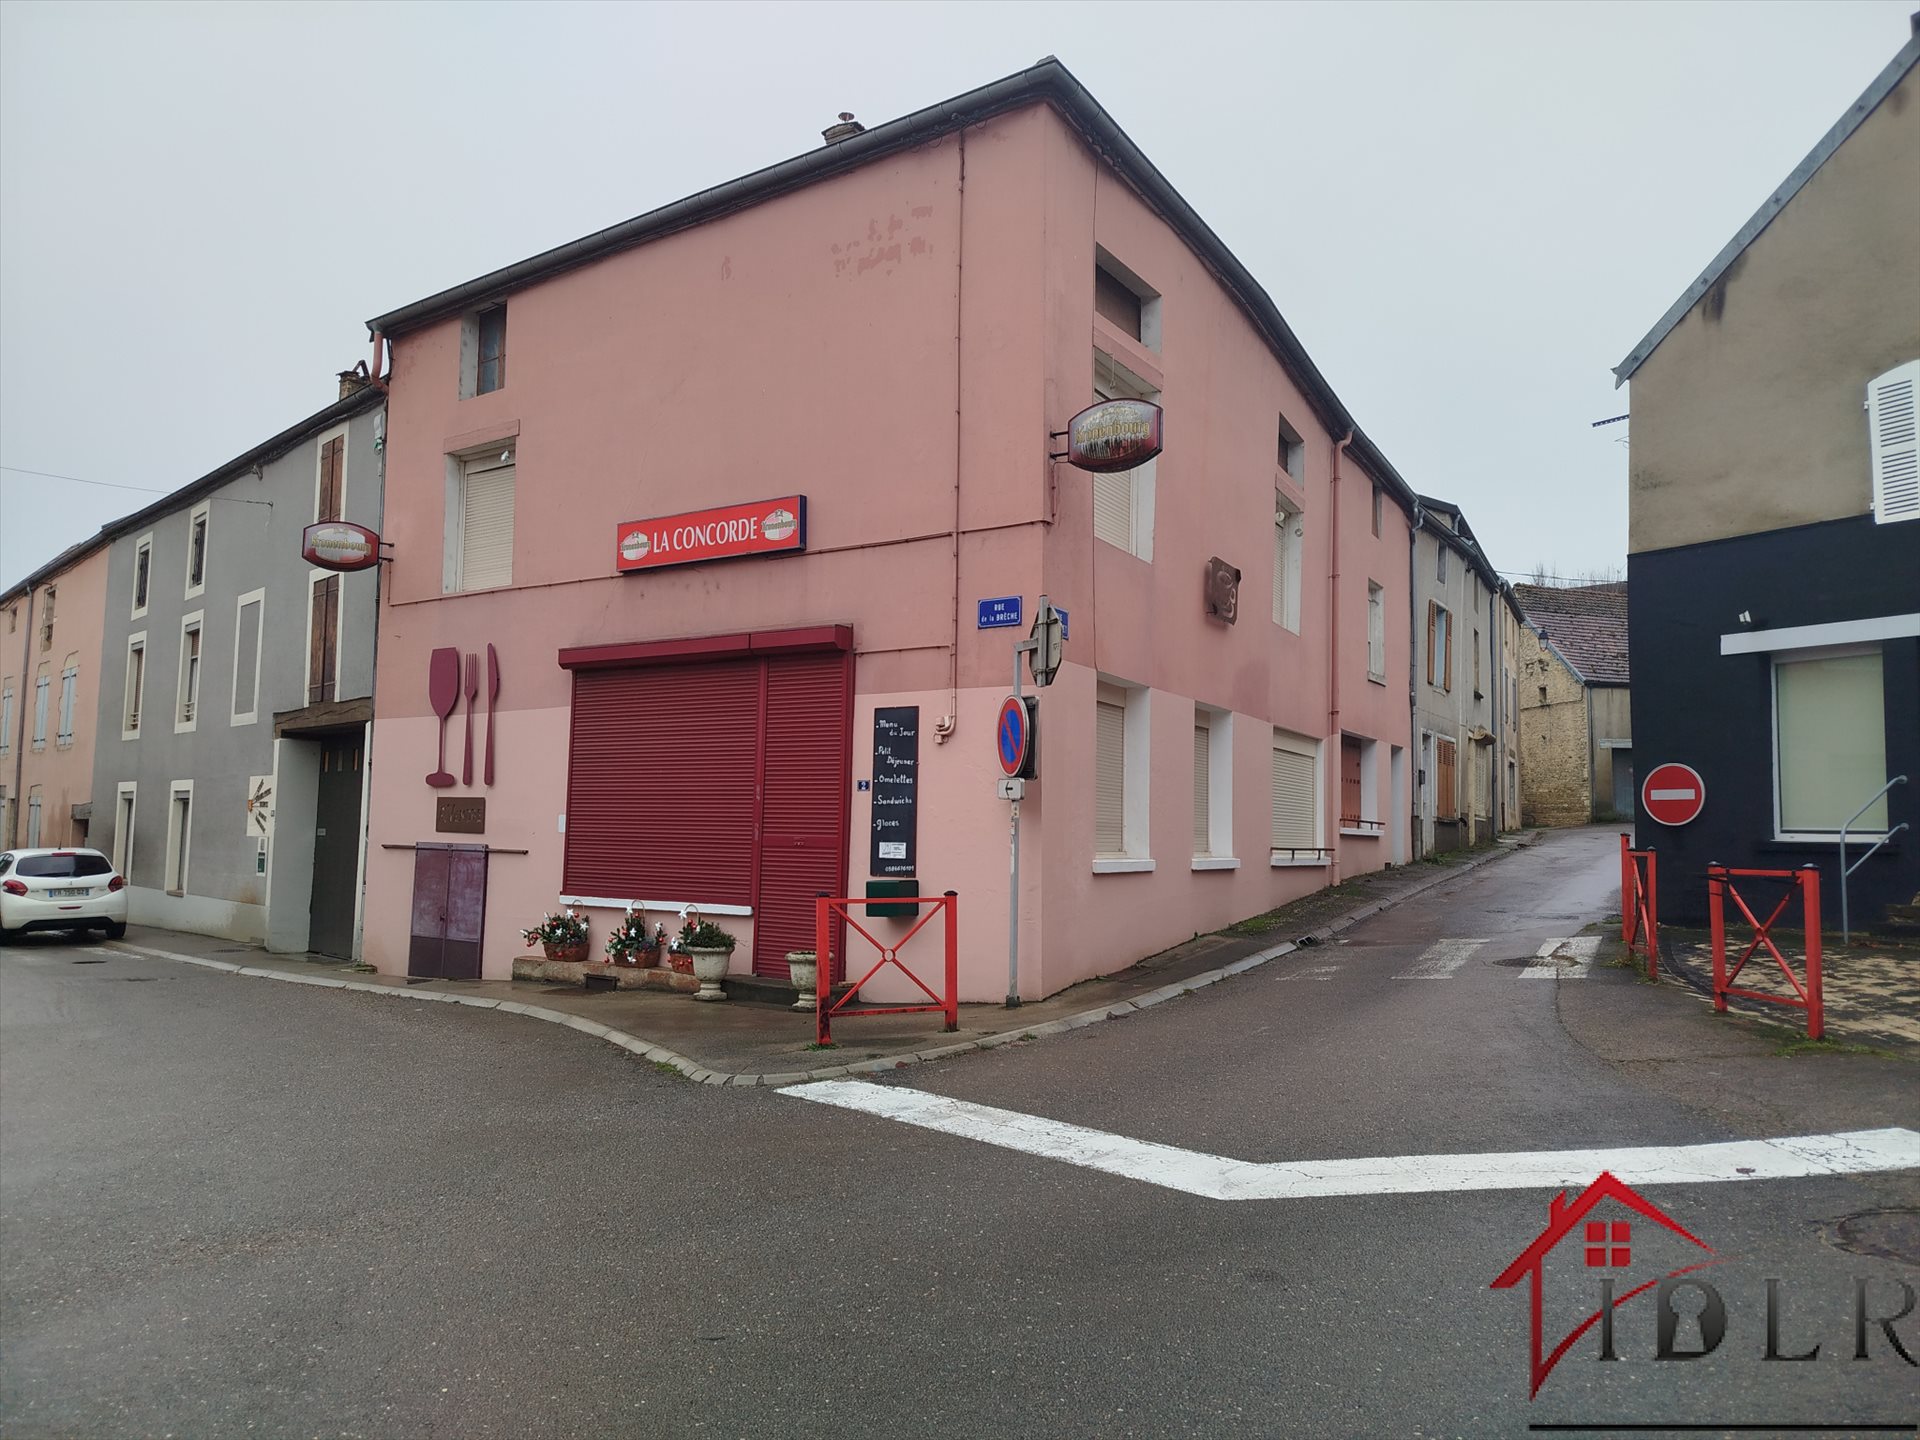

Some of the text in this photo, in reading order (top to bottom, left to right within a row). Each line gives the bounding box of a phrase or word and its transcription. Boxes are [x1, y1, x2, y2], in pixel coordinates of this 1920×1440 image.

[653, 517, 757, 553] LA CONCORDE
[994, 603, 1005, 611] RUE
[878, 745, 892, 755] Petit
[879, 773, 913, 784] Omelettes
